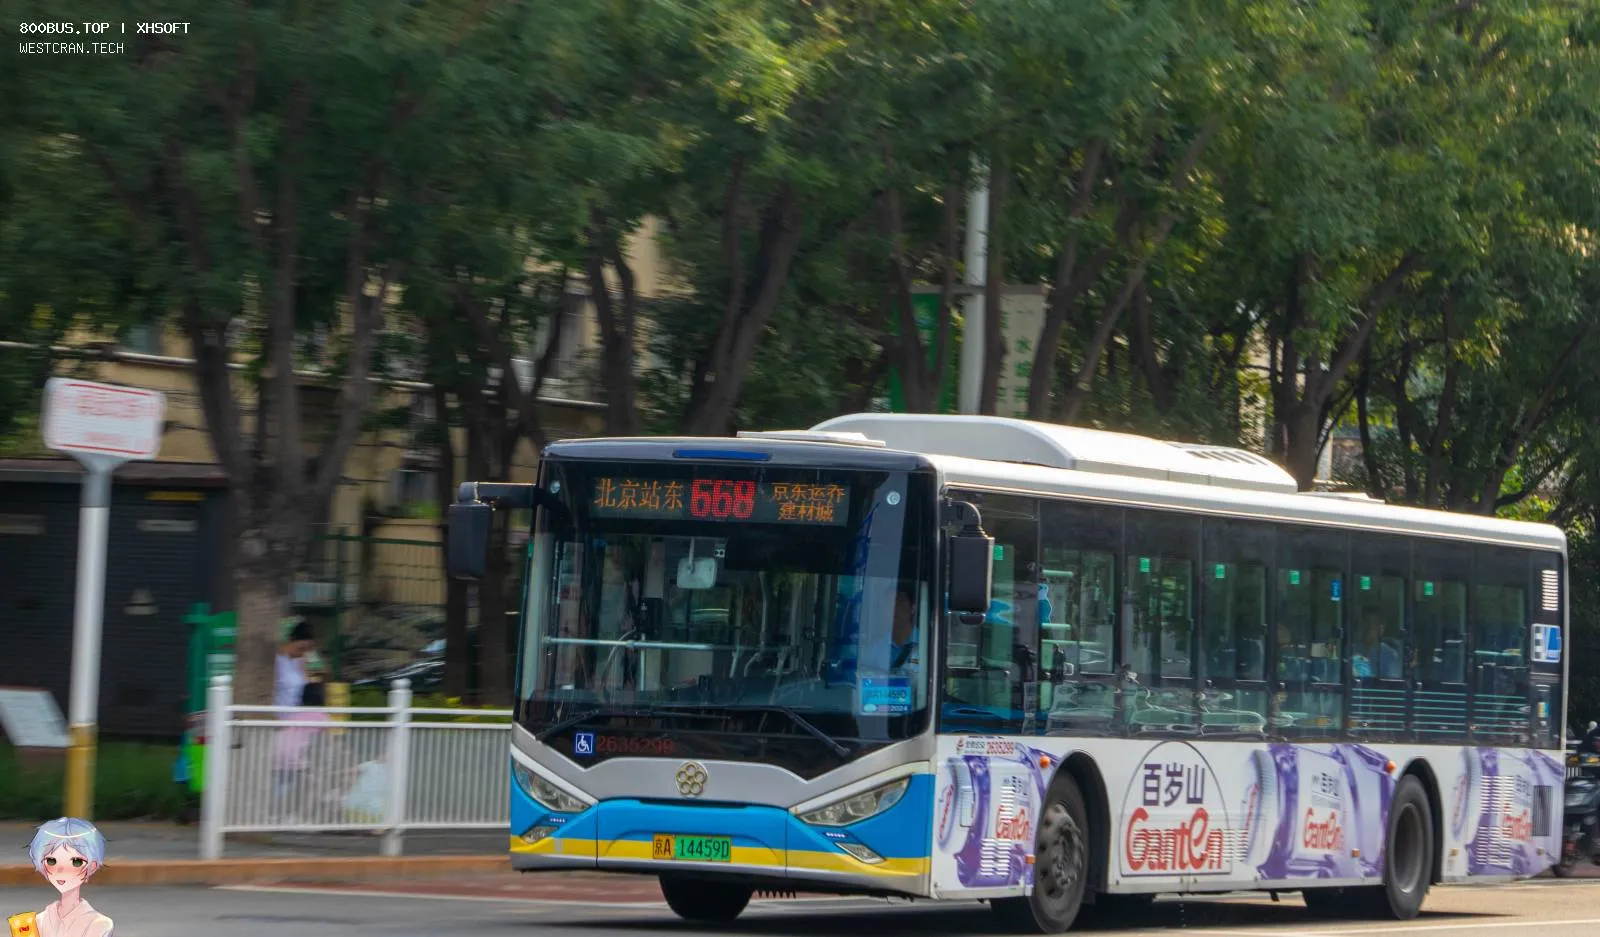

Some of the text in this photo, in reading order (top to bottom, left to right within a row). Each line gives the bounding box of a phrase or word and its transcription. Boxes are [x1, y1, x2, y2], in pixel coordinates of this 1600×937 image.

[594, 477, 684, 511] 北京站东
[690, 479, 755, 518] 668
[1143, 762, 1206, 807] 百岁山
[680, 839, 729, 859] 14459D
